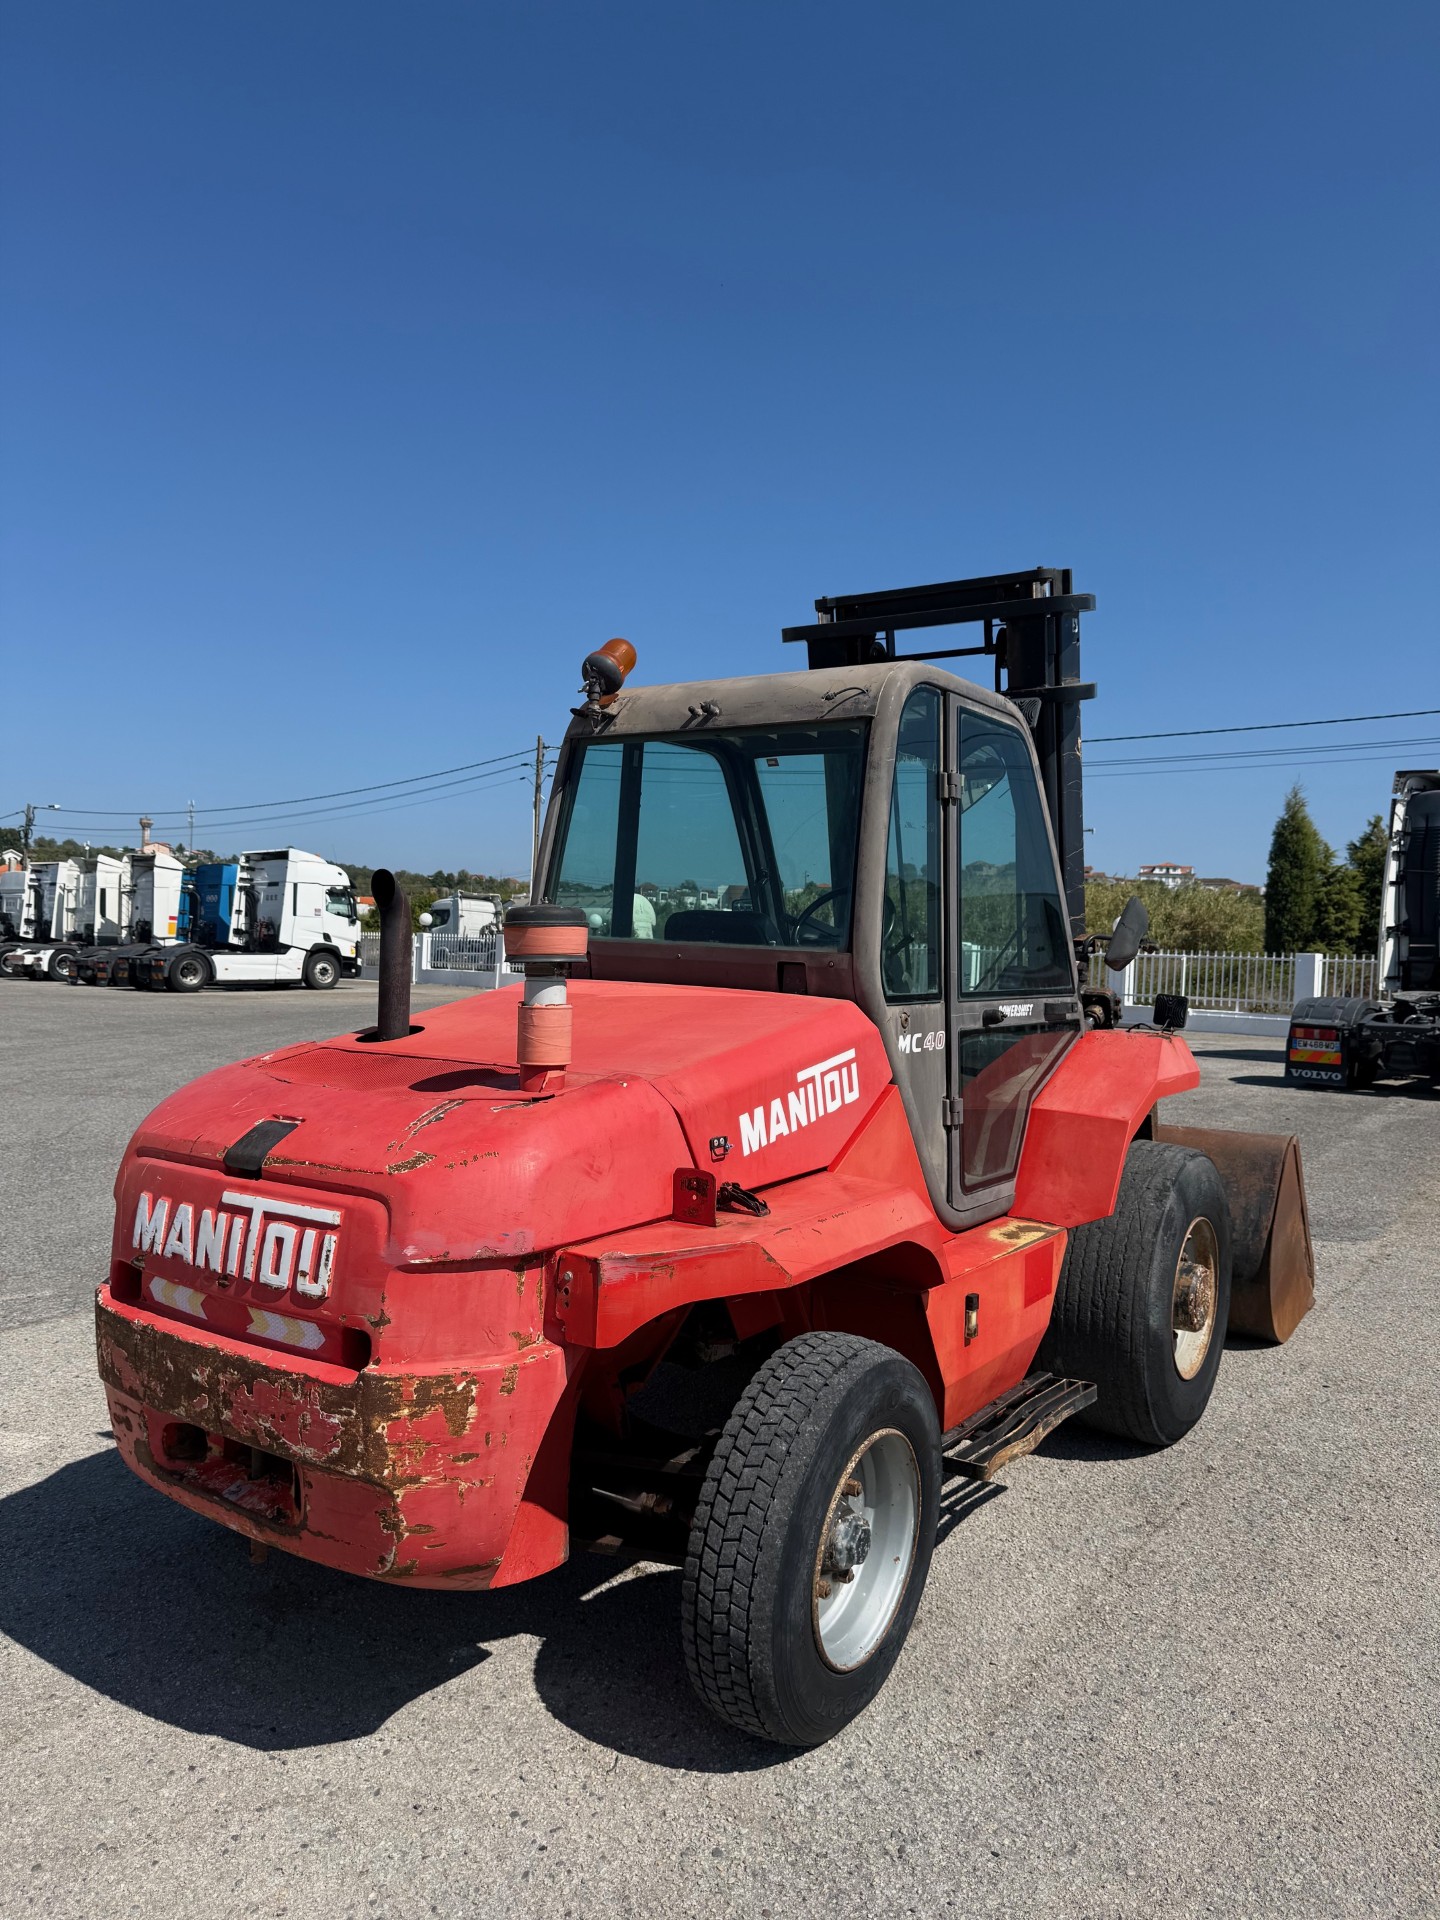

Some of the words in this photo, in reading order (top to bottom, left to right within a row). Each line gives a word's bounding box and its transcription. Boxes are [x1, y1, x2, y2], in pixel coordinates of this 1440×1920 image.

[738, 1047, 860, 1157] MANITOU
[1289, 1068, 1342, 1080] VOLVO
[132, 1190, 343, 1299] MANITOU
